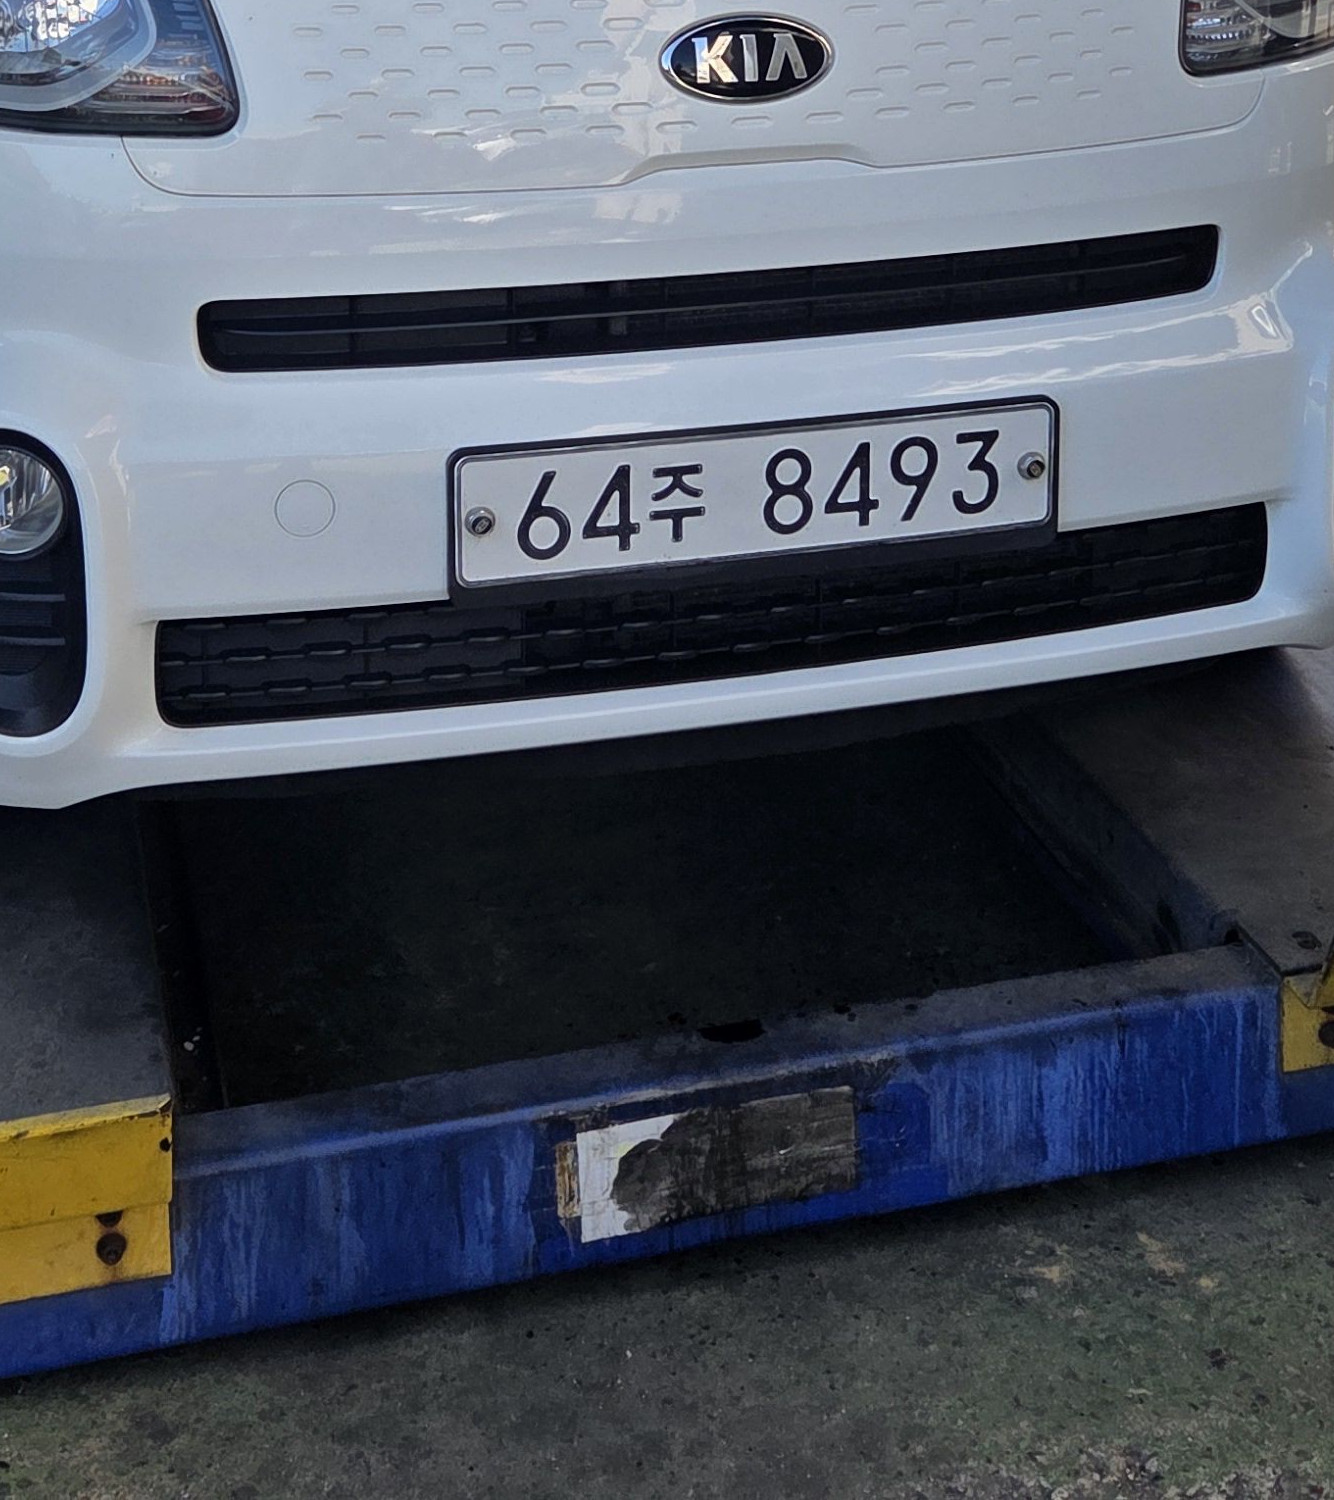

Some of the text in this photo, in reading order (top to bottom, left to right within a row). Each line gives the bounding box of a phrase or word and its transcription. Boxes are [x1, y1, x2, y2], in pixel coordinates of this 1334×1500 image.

[691, 32, 808, 84] KIA
[517, 429, 1001, 560] 64주 8493
